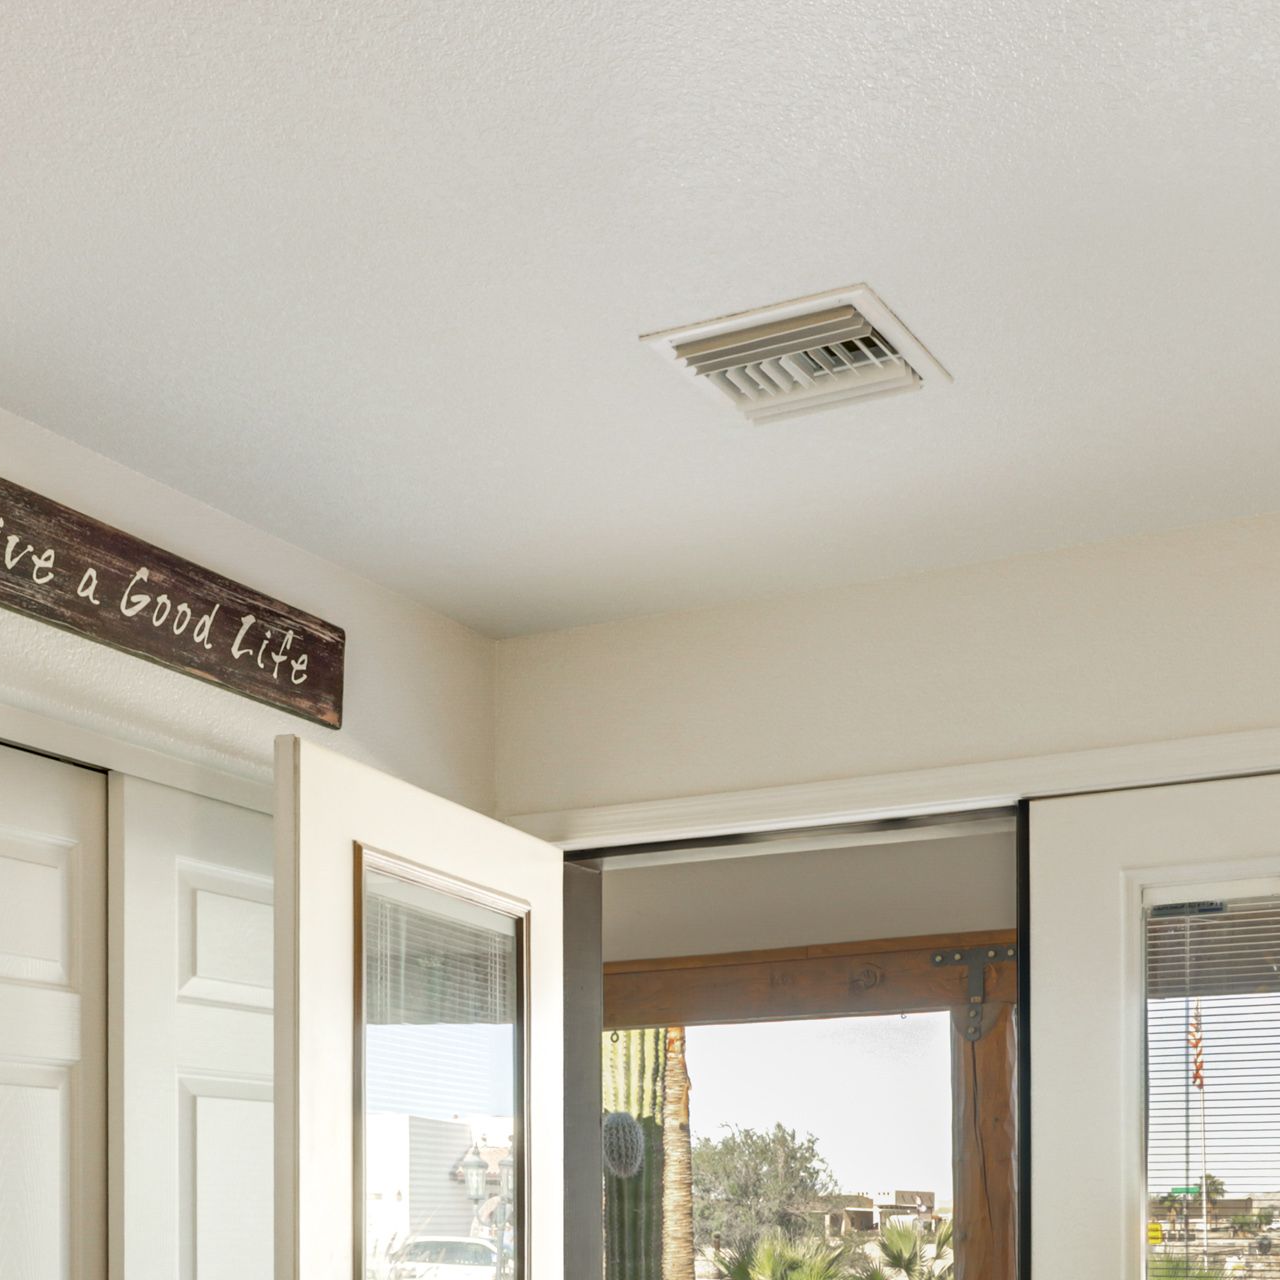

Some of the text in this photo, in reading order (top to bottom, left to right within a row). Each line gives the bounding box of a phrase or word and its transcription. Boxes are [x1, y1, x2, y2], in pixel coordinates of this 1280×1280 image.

[76, 567, 100, 605] a
[120, 567, 220, 651] Good
[231, 614, 308, 685] Life
